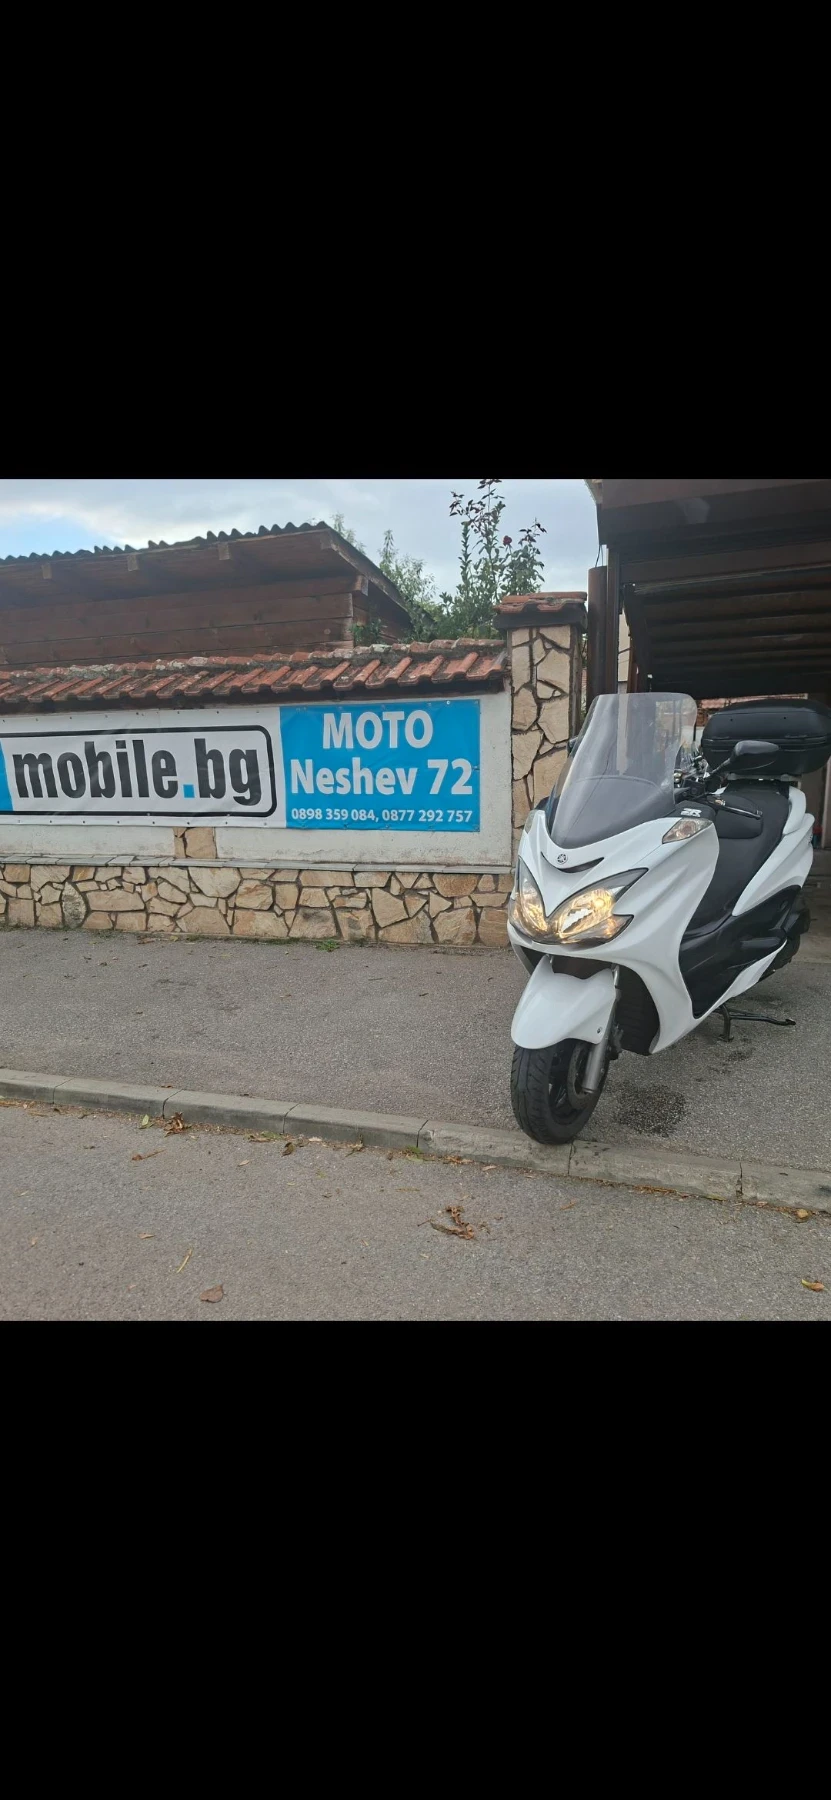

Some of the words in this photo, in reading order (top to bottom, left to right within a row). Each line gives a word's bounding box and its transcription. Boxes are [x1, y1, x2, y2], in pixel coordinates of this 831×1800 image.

[322, 709, 434, 749] MOTO
[12, 738, 262, 806] mobile.bg
[290, 756, 418, 795] Neshev
[427, 758, 473, 795] 72
[291, 807, 323, 821] 0898
[325, 808, 349, 821] 359
[351, 809, 379, 823] 084,
[381, 809, 414, 822] 0877
[418, 809, 444, 823] 292
[447, 810, 473, 823] 757
